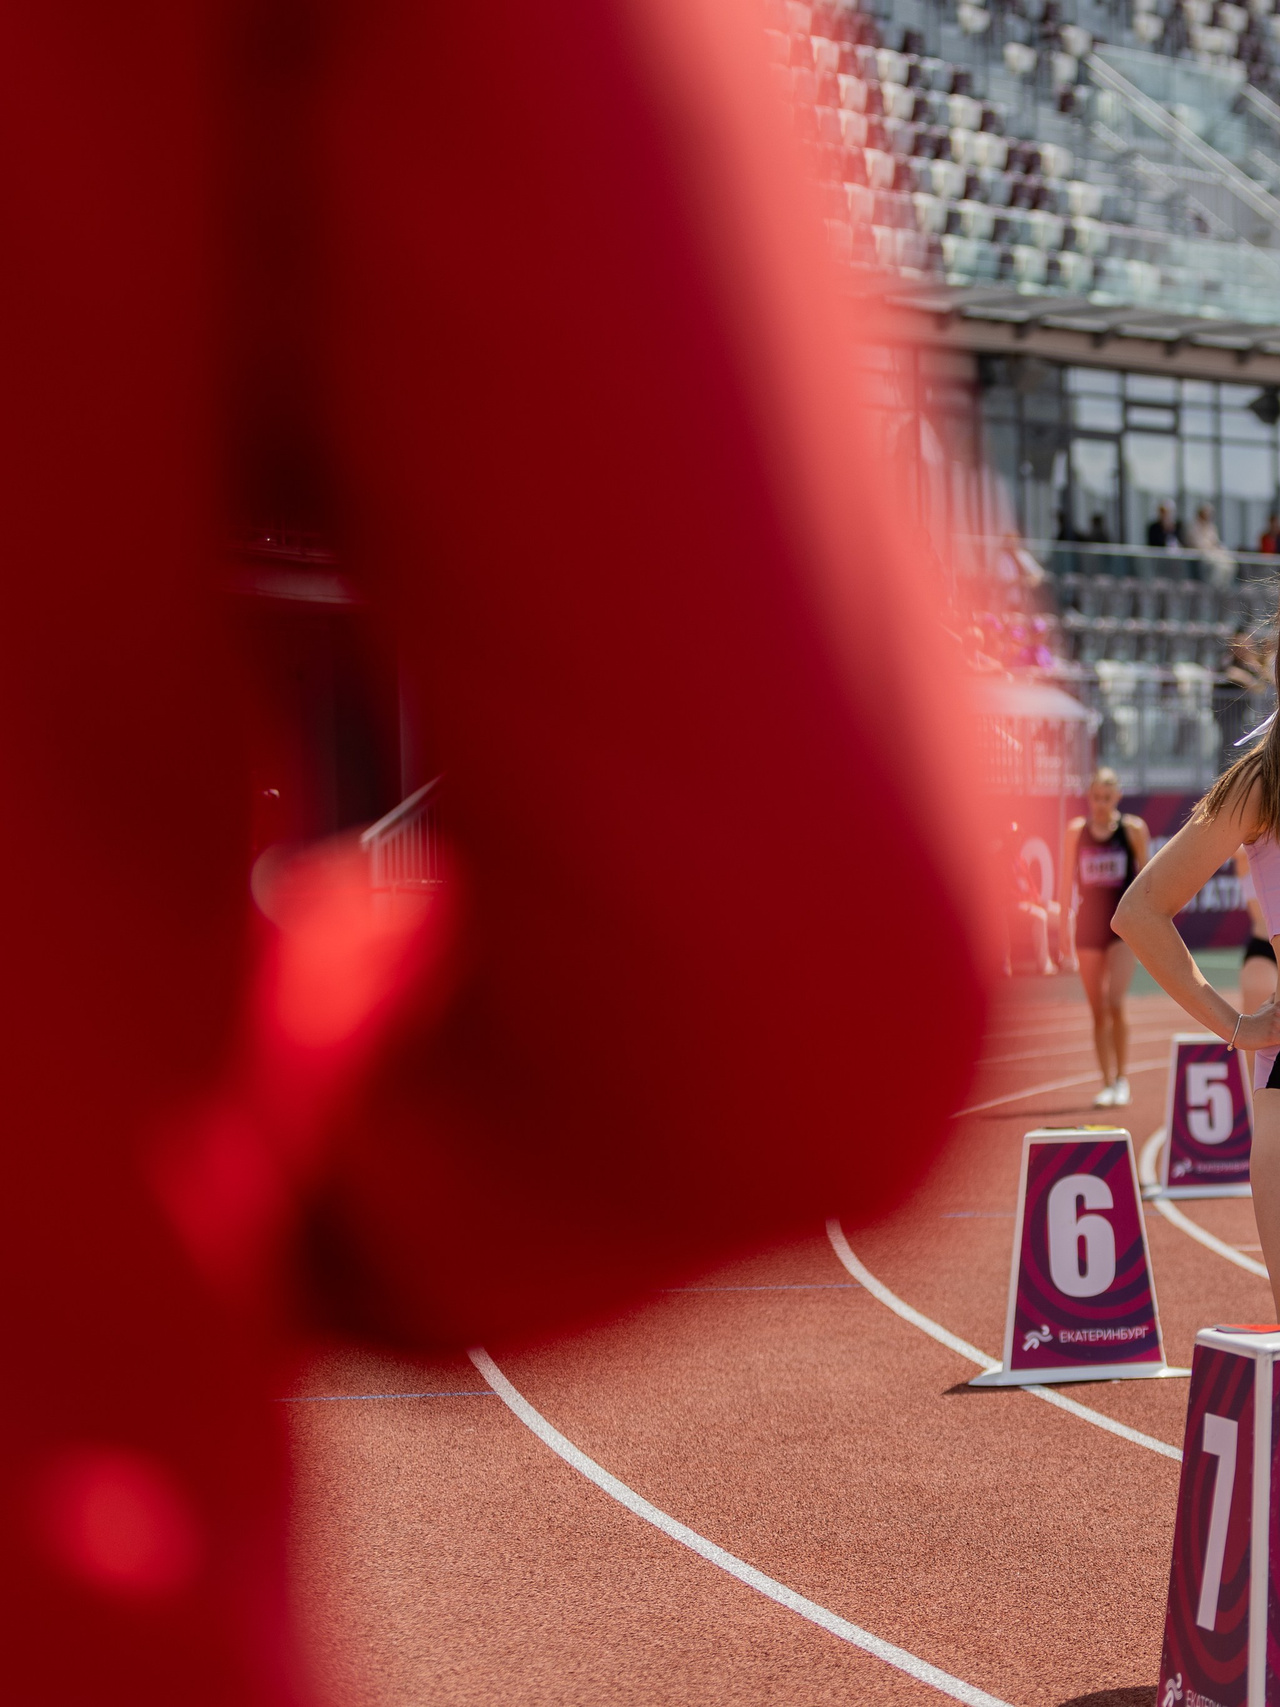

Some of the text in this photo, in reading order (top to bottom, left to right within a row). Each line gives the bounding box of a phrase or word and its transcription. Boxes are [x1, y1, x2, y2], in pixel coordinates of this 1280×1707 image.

[1187, 1062, 1234, 1145] 5
[1047, 1173, 1116, 1298] 6
[1059, 1326, 1149, 1344] ЕКАТЕРИНБУРГ
[1196, 1412, 1238, 1632] 7
